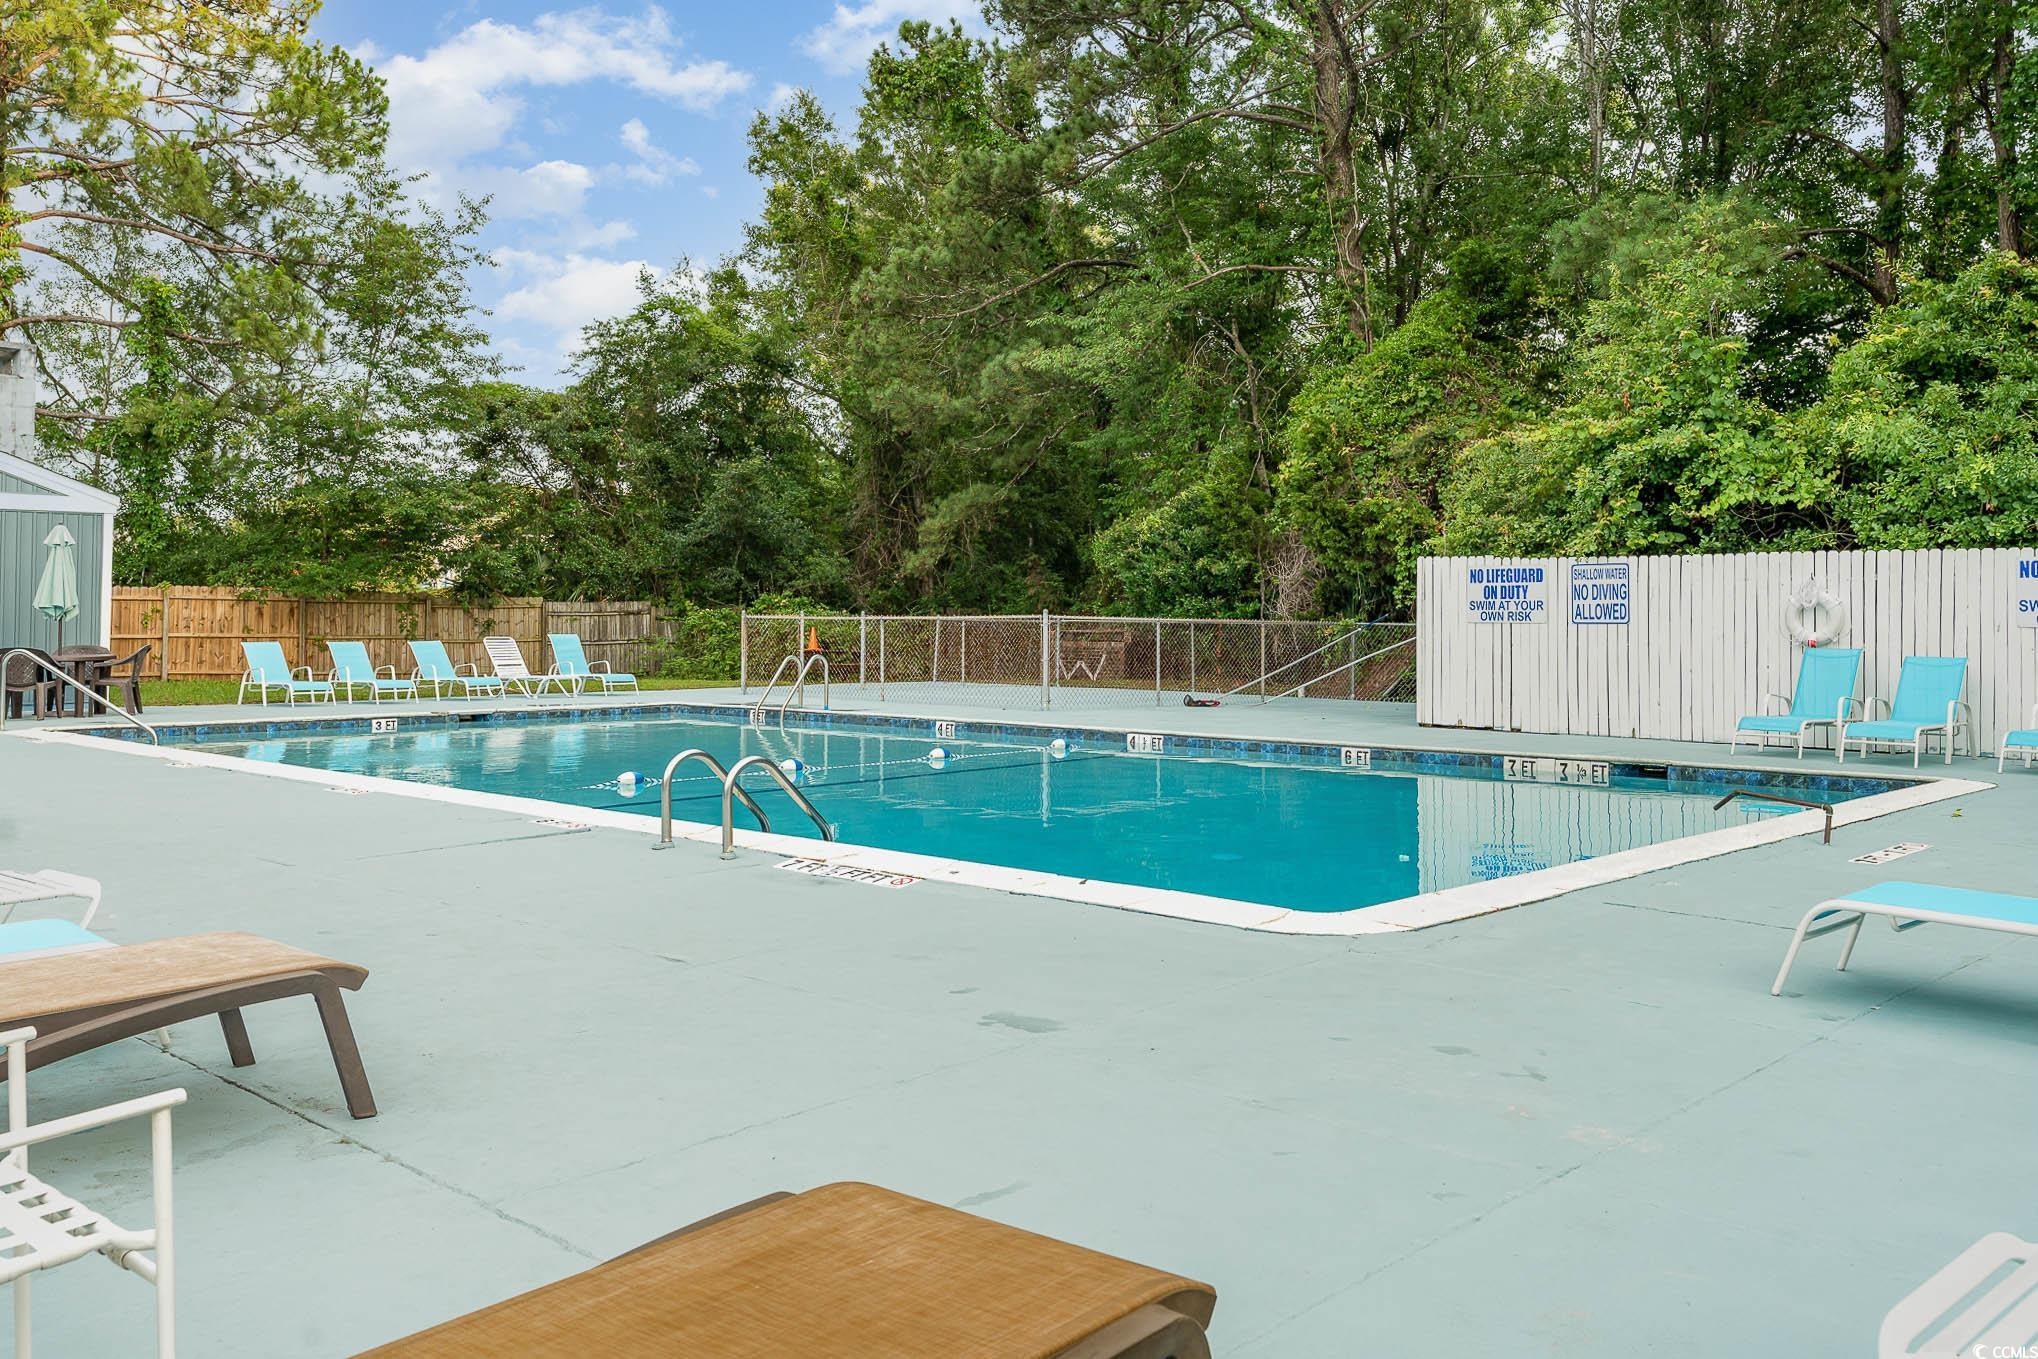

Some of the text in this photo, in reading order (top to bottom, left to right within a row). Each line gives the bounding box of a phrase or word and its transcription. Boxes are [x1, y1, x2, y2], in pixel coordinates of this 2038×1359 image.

[1470, 568, 1544, 584] NO LIFEGUARD
[1573, 568, 1627, 580] SHALLOW WATER
[2020, 560, 2038, 578] NO
[1483, 584, 1529, 600] ON DUTY
[1573, 583, 1627, 601] NO DIVING
[1469, 600, 1544, 611] SWIM AT YOUR
[1574, 603, 1627, 620] ALLOWED
[1480, 611, 1532, 622] OWN RISK
